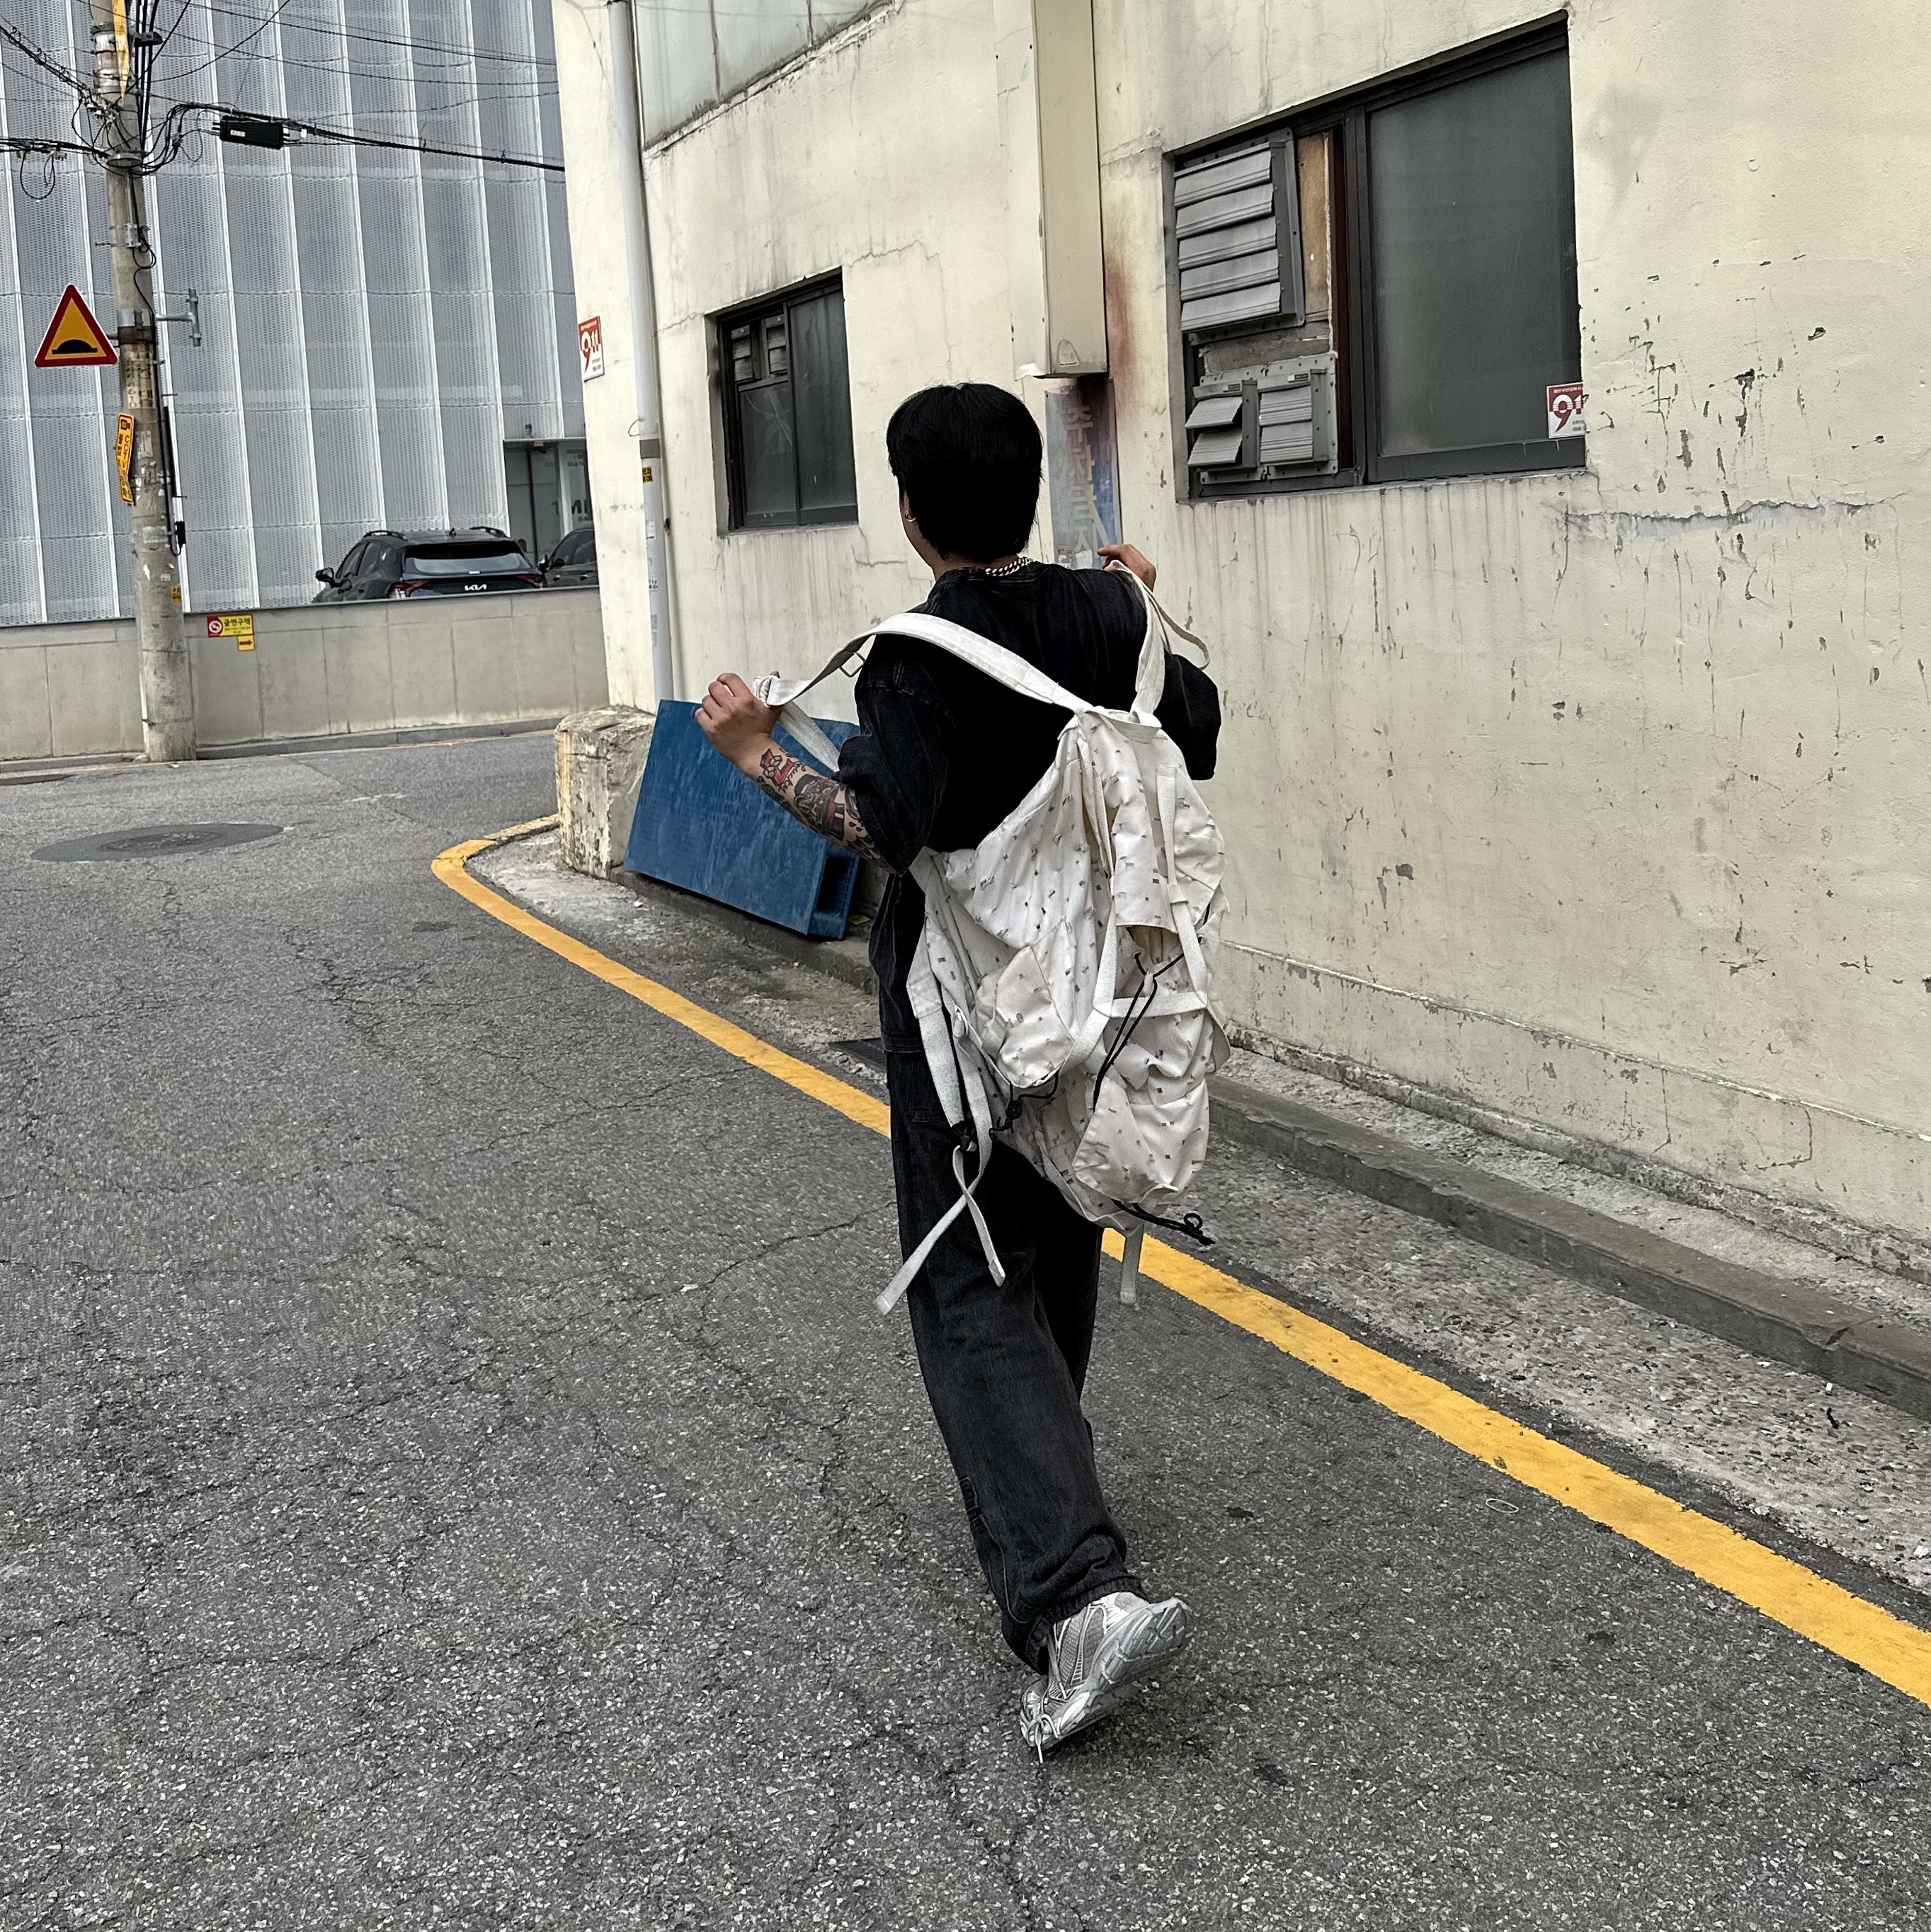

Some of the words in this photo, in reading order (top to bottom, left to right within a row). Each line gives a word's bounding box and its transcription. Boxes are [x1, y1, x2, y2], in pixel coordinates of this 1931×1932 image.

[581, 329, 599, 373] 911
[1552, 394, 1583, 433] 91
[122, 435, 130, 469] CCTV
[1065, 405, 1096, 559] 주차금지
[464, 583, 487, 592] KIA
[223, 617, 251, 627] 금연구역
